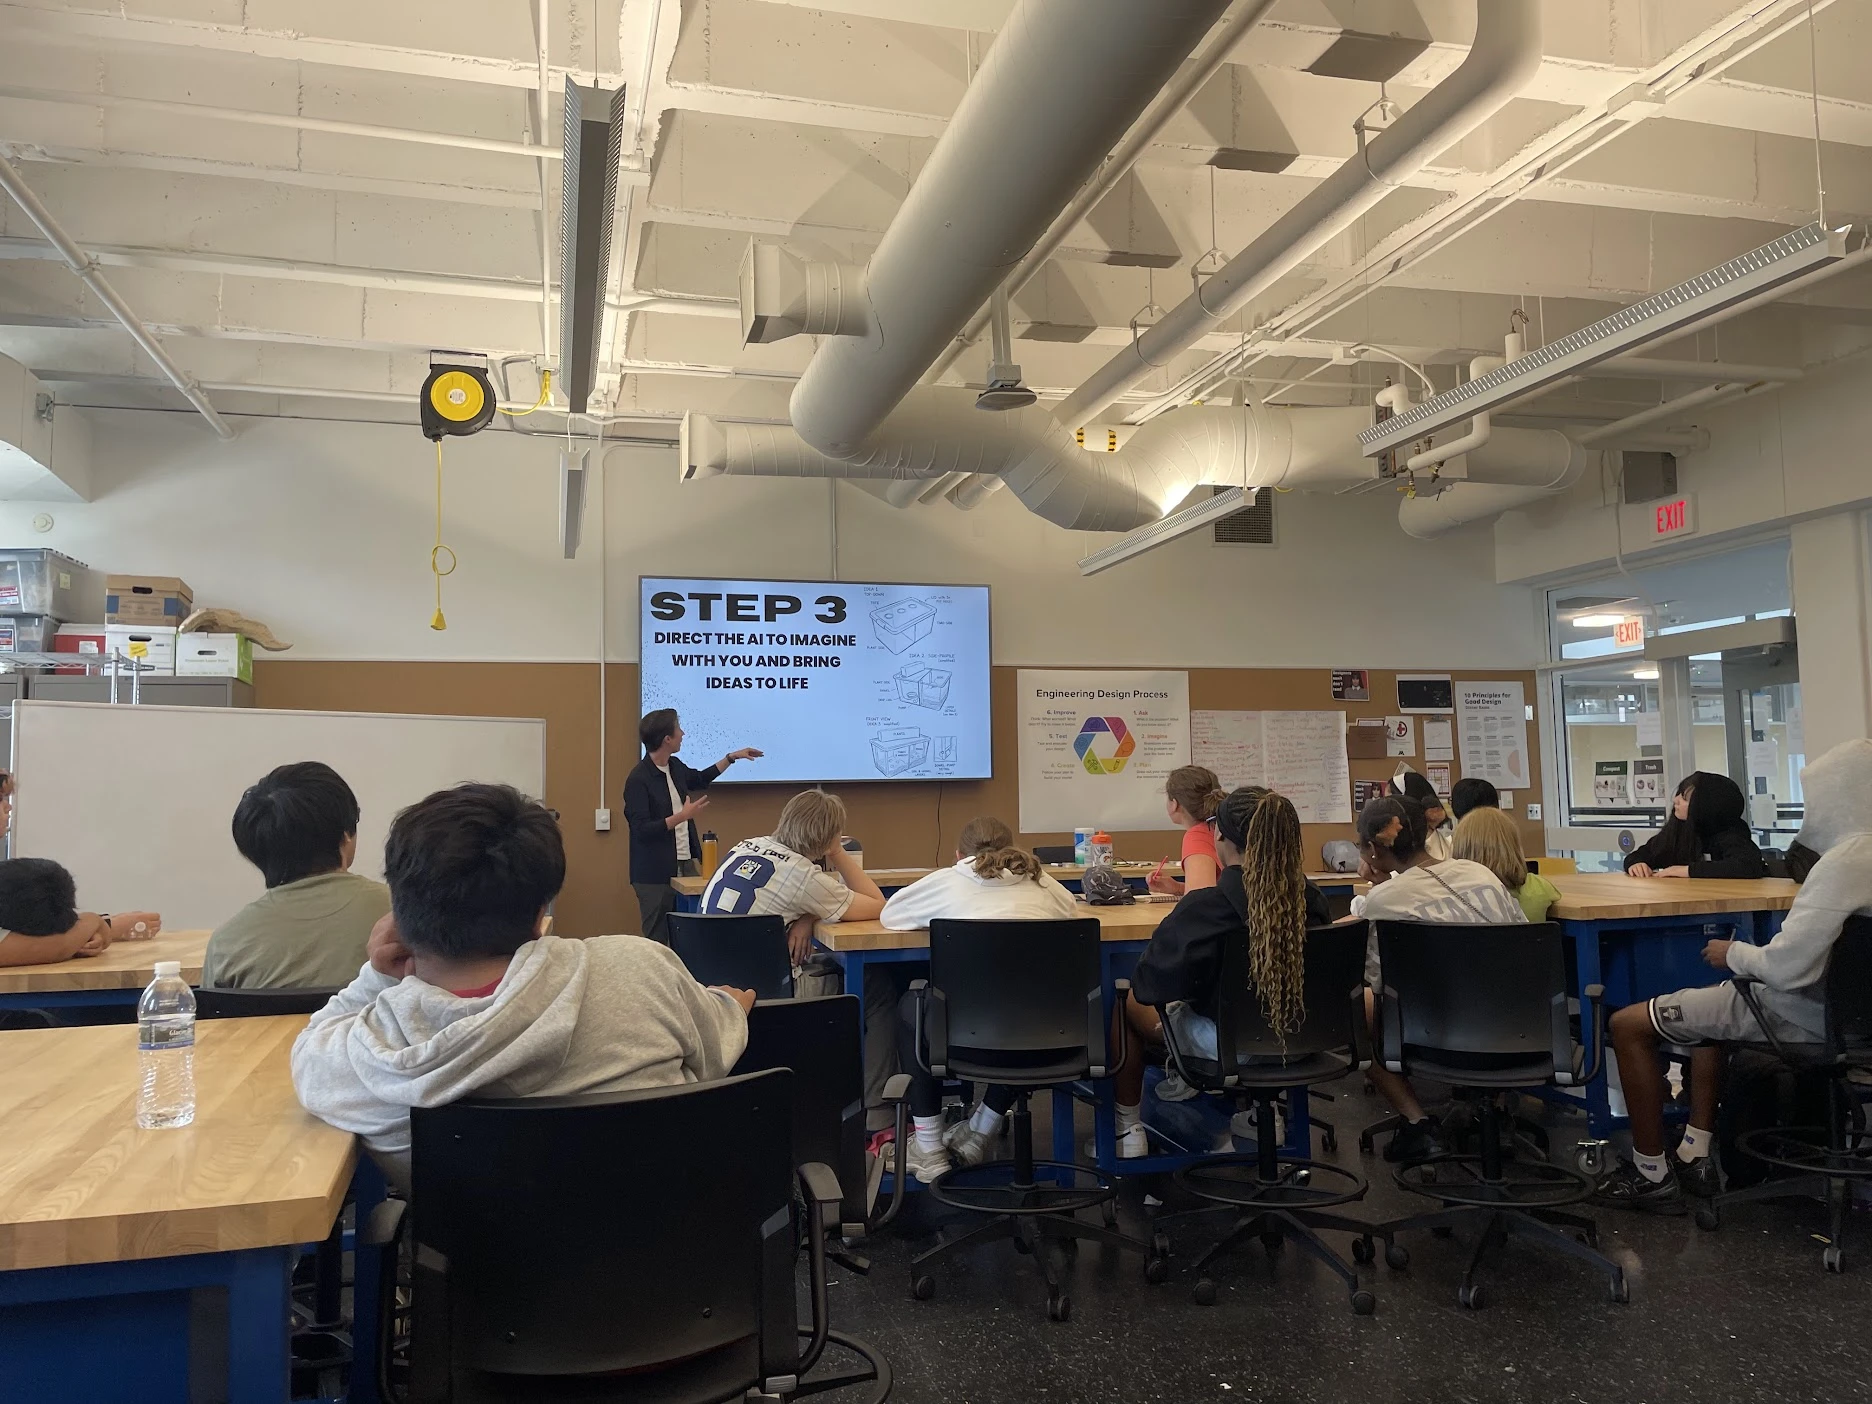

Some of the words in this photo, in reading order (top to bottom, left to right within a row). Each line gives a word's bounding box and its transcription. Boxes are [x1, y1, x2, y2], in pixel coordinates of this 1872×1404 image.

[1657, 500, 1686, 533] EXIT
[650, 592, 802, 622] STEP
[814, 596, 847, 624] 3
[654, 632, 712, 645] DIRECT
[715, 633, 745, 645] THE
[747, 634, 763, 645] AI
[766, 634, 788, 646] TO
[790, 634, 856, 646] IMAGINE
[1619, 622, 1638, 642] EXIT
[672, 654, 716, 666] WITH
[718, 655, 752, 667] YOU
[756, 656, 791, 667] AND
[793, 656, 841, 668] BRING
[706, 677, 753, 689] IDEAS
[755, 677, 777, 689] TO
[779, 678, 808, 689] LIFE
[1036, 690, 1095, 699] Engineering
[1097, 690, 1131, 700] Design
[1134, 690, 1168, 698] Process
